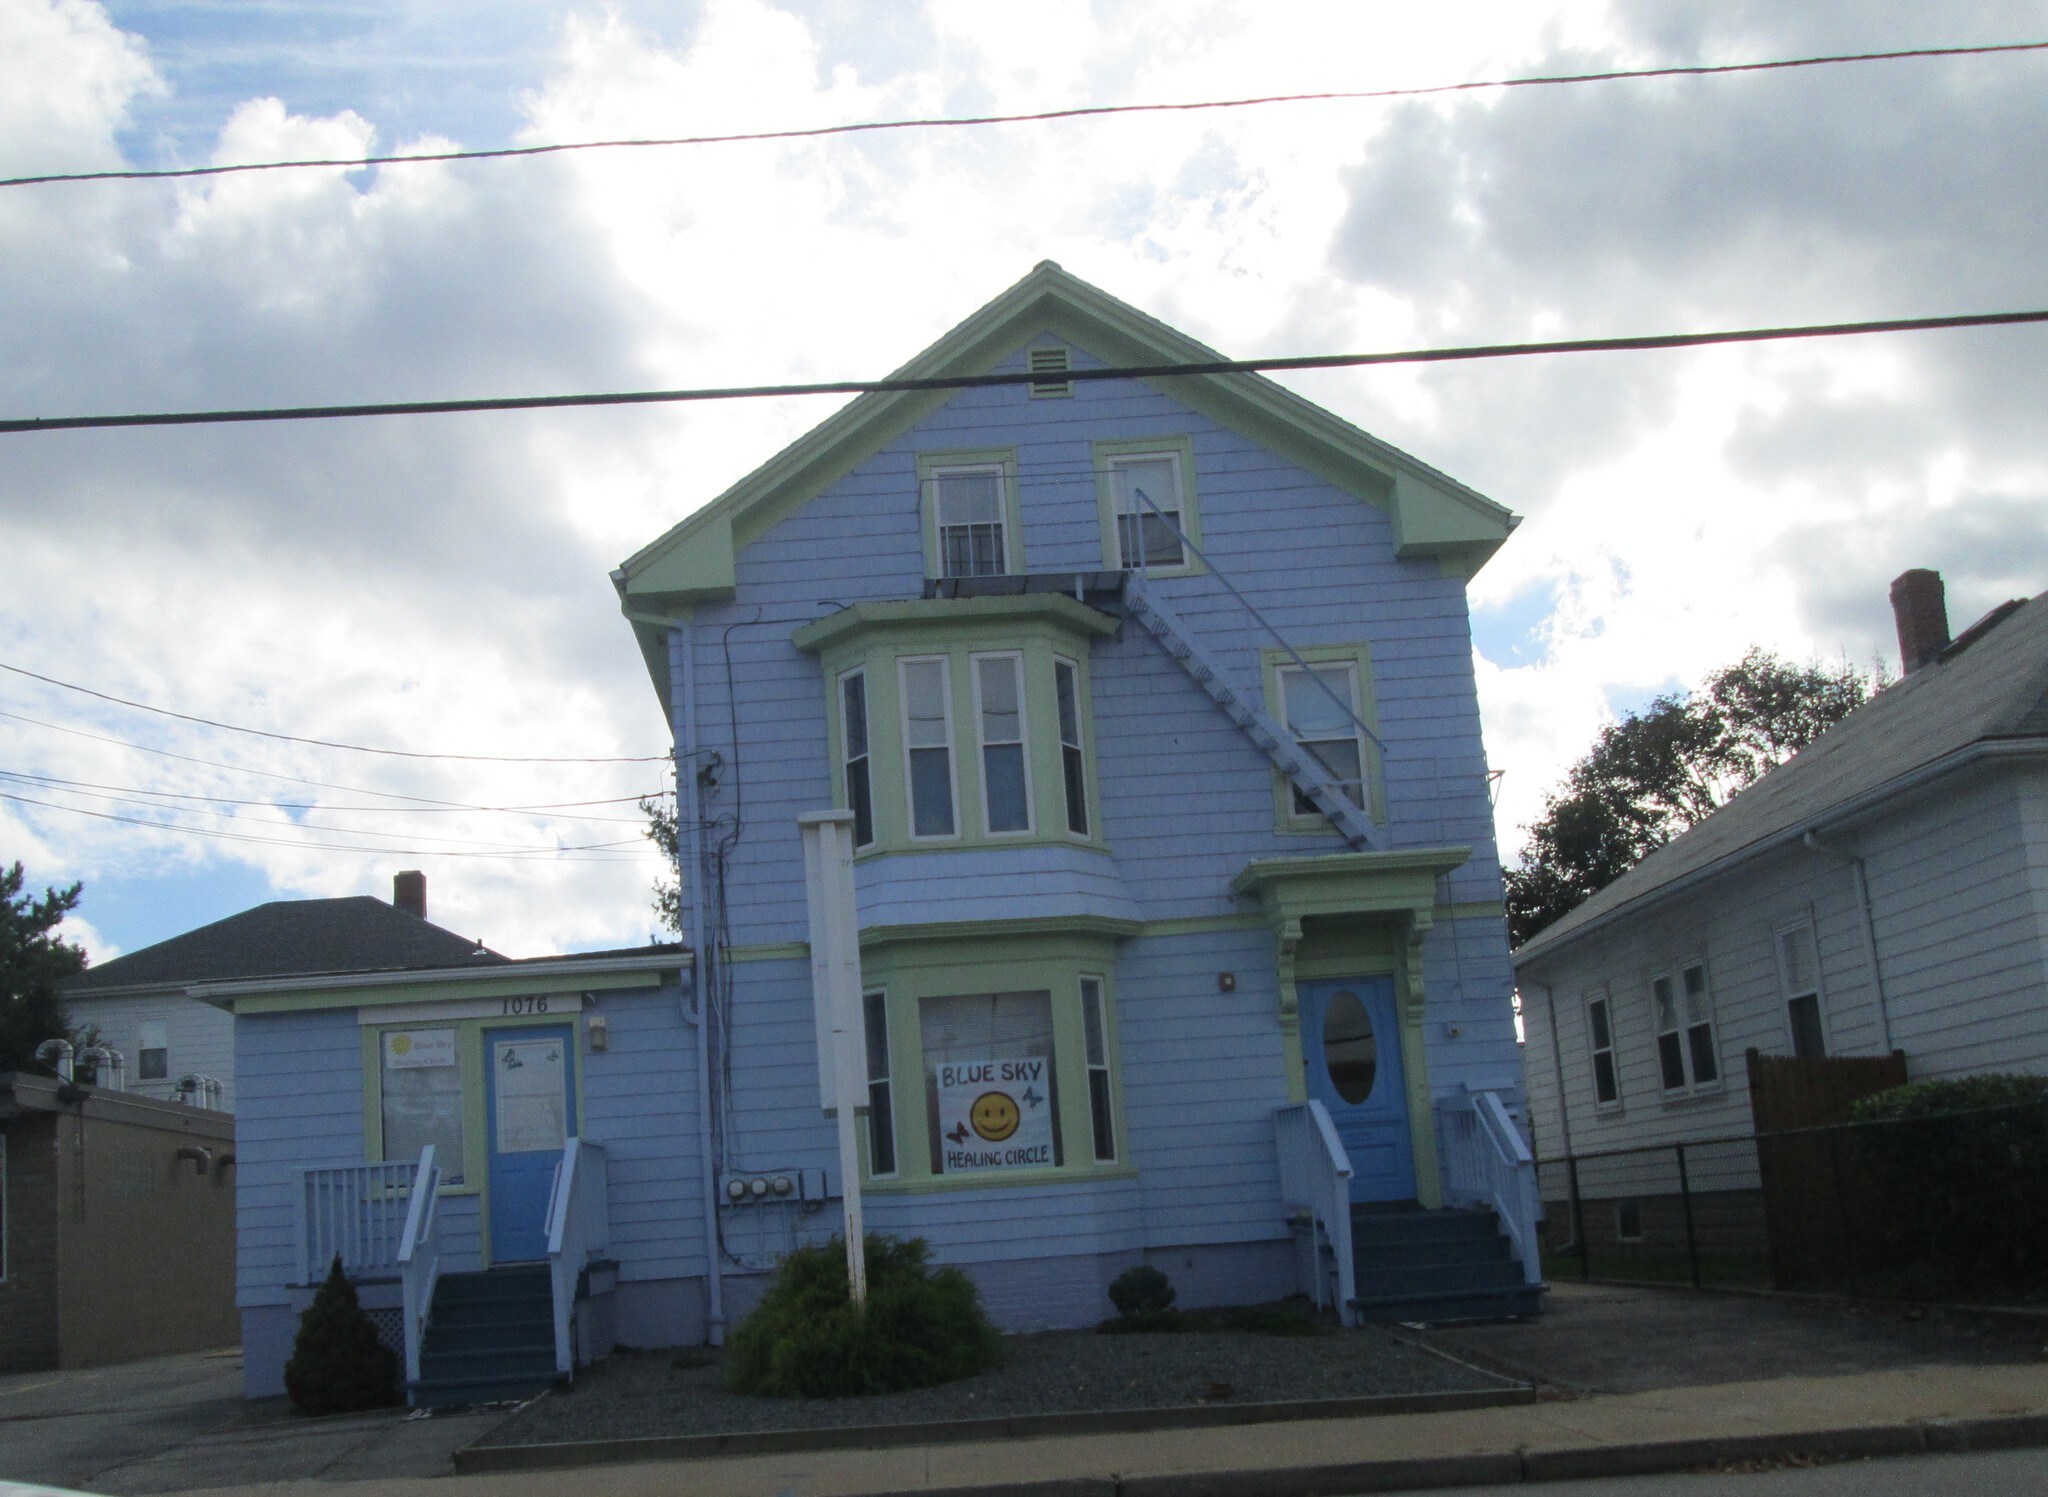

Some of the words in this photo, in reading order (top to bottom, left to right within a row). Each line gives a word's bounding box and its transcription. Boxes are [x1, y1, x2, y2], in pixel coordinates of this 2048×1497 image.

[502, 996, 548, 1014] 1076
[942, 1065, 994, 1087] BLUE
[1001, 1061, 1042, 1081] SKY
[947, 1151, 1002, 1168] HEALING
[1005, 1145, 1049, 1165] CIRCLE
